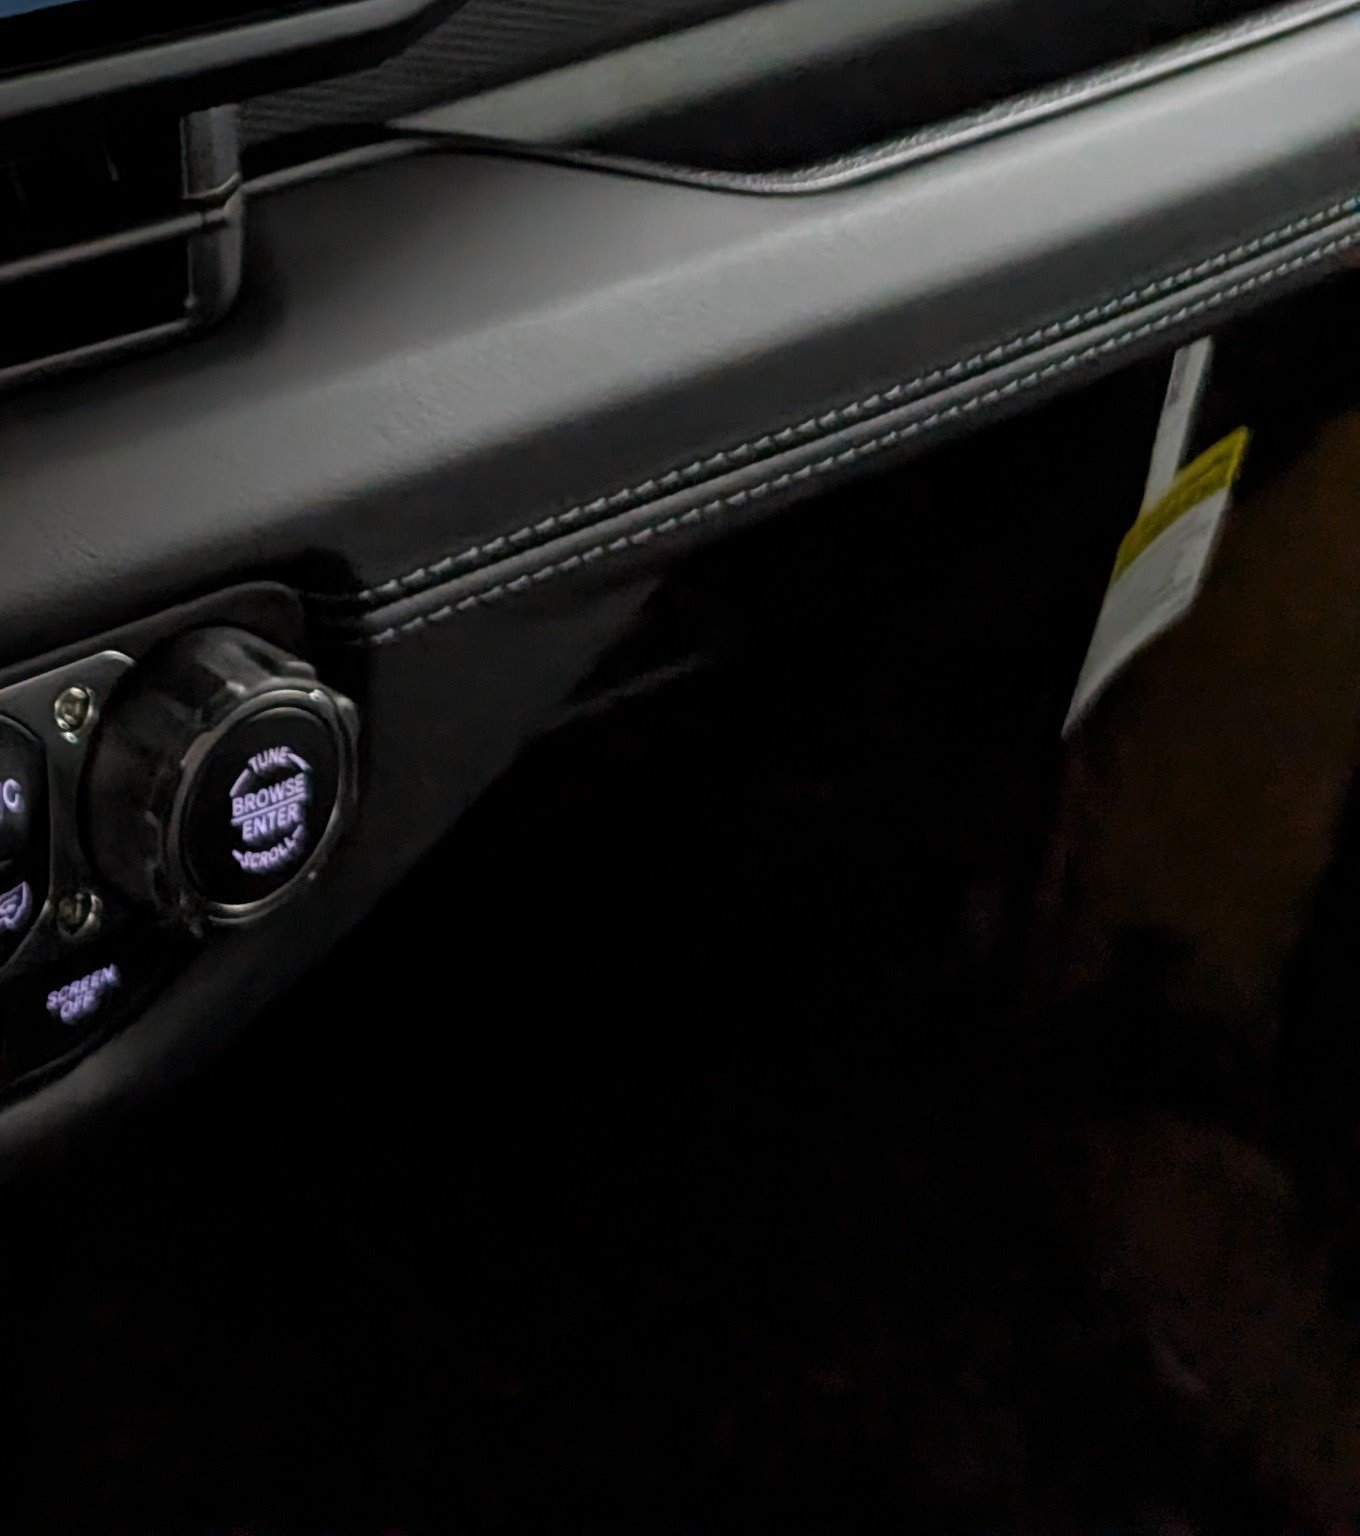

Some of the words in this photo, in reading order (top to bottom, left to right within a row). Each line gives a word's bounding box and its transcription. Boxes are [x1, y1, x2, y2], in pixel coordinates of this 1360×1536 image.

[248, 746, 291, 774] TUNE
[232, 772, 306, 815] BROWSE
[242, 803, 300, 841] ENTER
